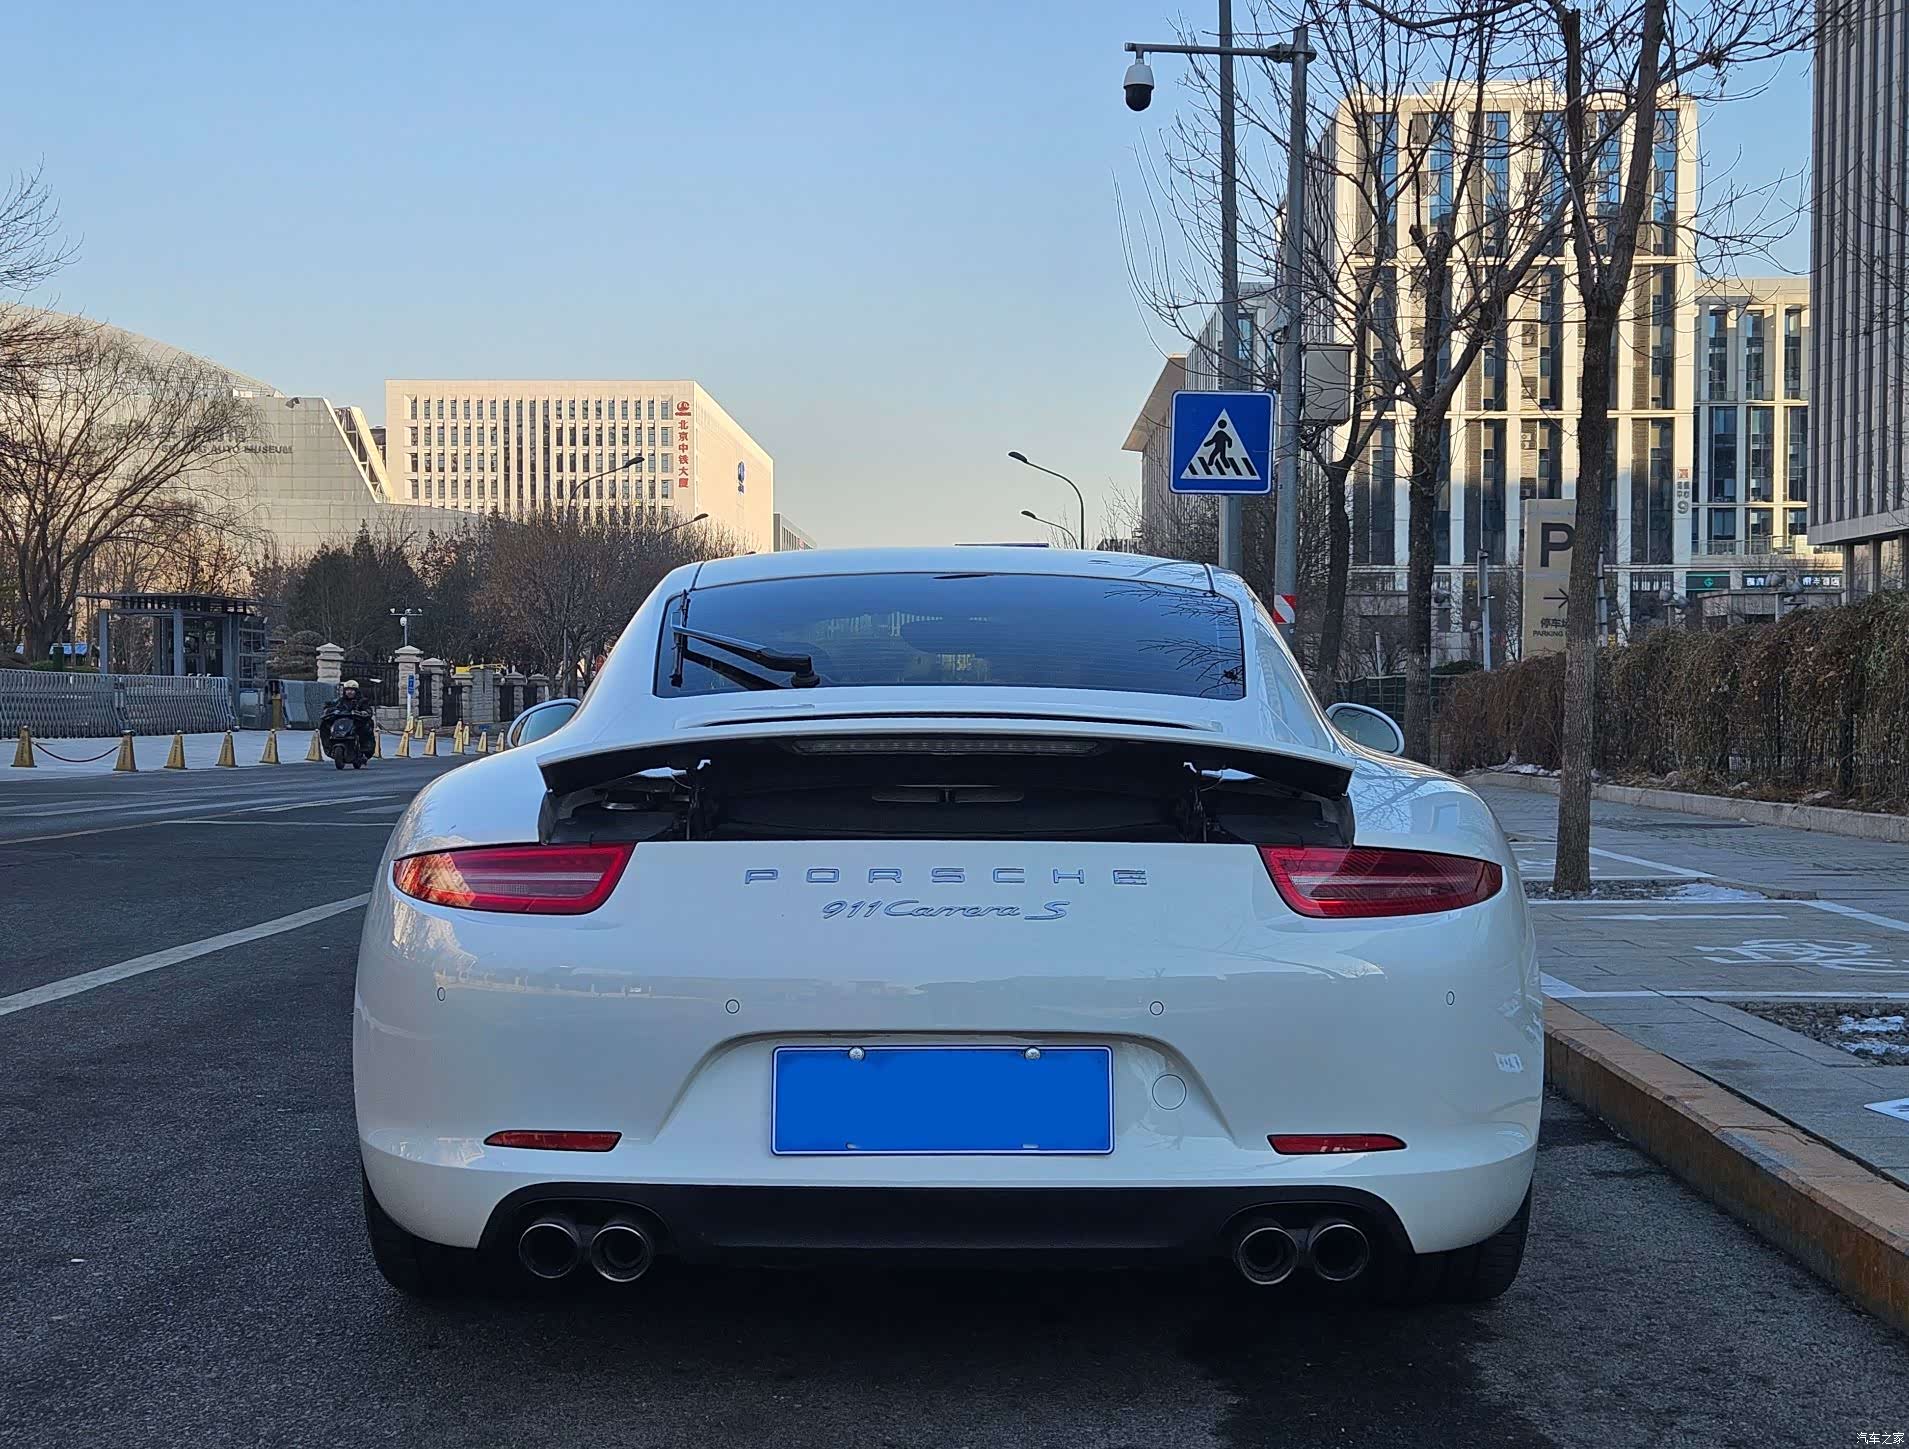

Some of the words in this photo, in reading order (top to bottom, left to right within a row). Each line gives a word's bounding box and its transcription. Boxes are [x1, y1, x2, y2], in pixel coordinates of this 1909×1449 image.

[244, 445, 293, 454] MUSEUM
[1540, 522, 1576, 568] P
[744, 867, 1148, 886] PORSCHE
[822, 900, 884, 920] 911
[884, 899, 1021, 918] Carrera
[1024, 900, 1071, 921] S
